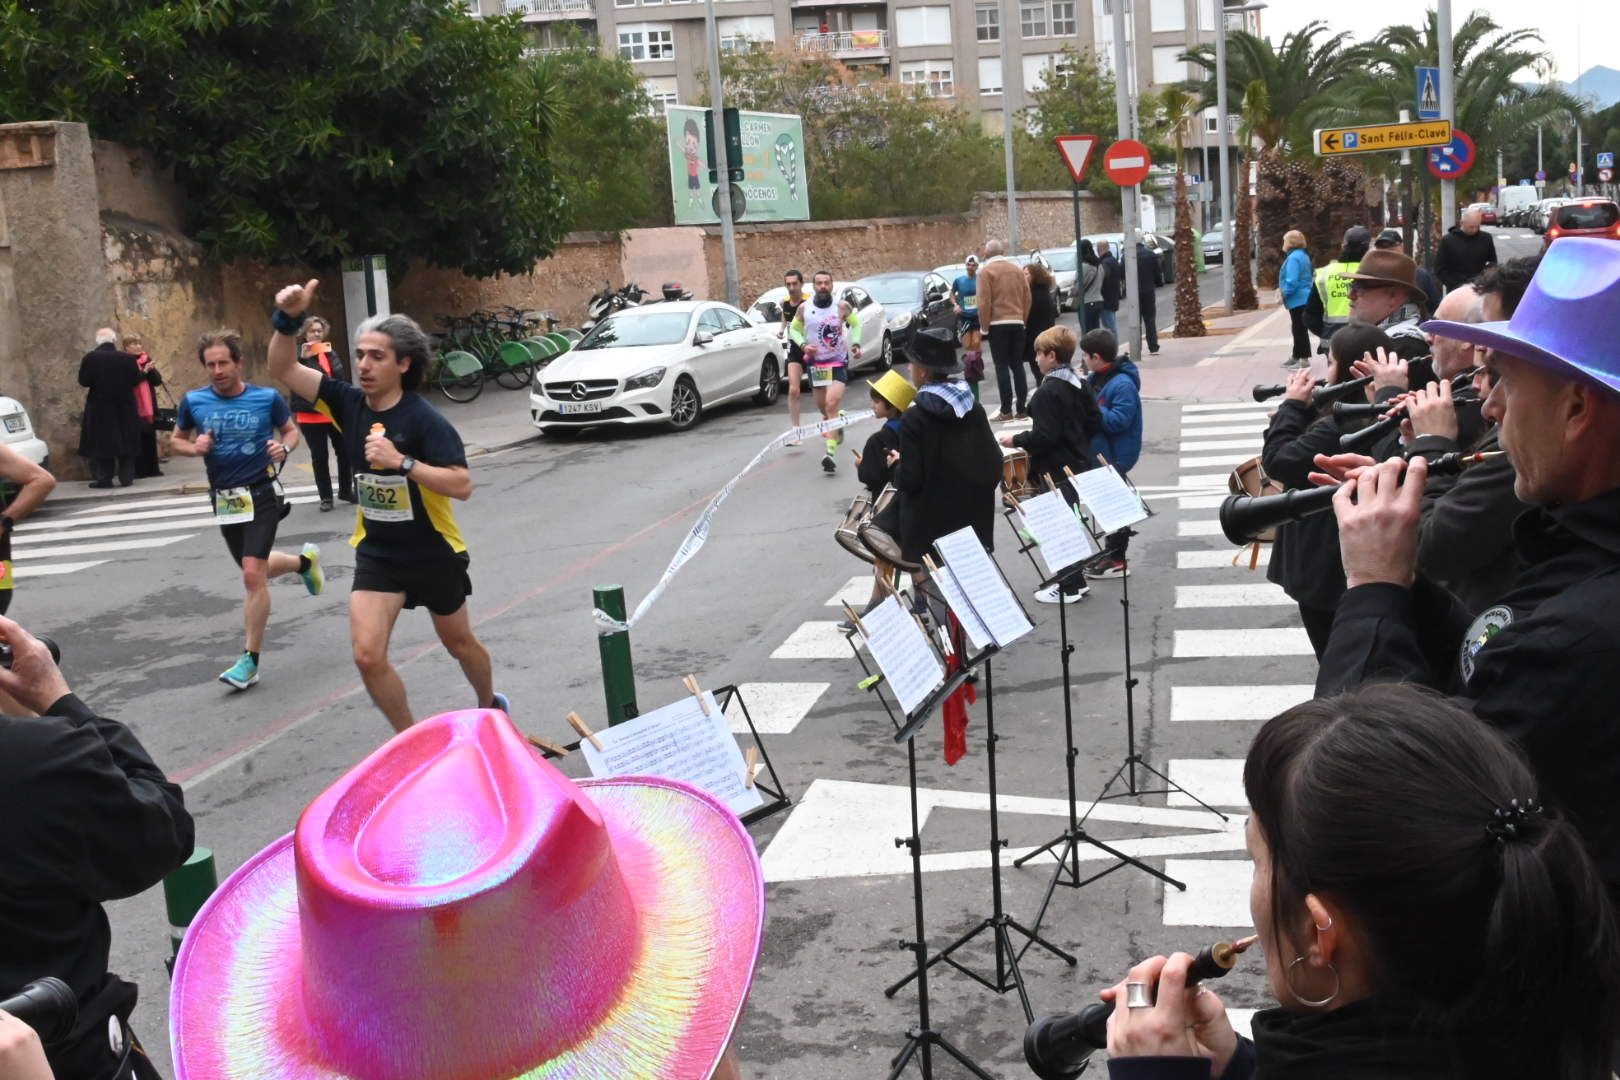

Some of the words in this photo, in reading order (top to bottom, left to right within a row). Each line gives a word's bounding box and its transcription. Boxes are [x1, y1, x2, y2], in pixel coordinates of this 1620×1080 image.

[1345, 134, 1354, 146] P
[1360, 133, 1384, 144] Sant
[366, 486, 398, 504] 262
